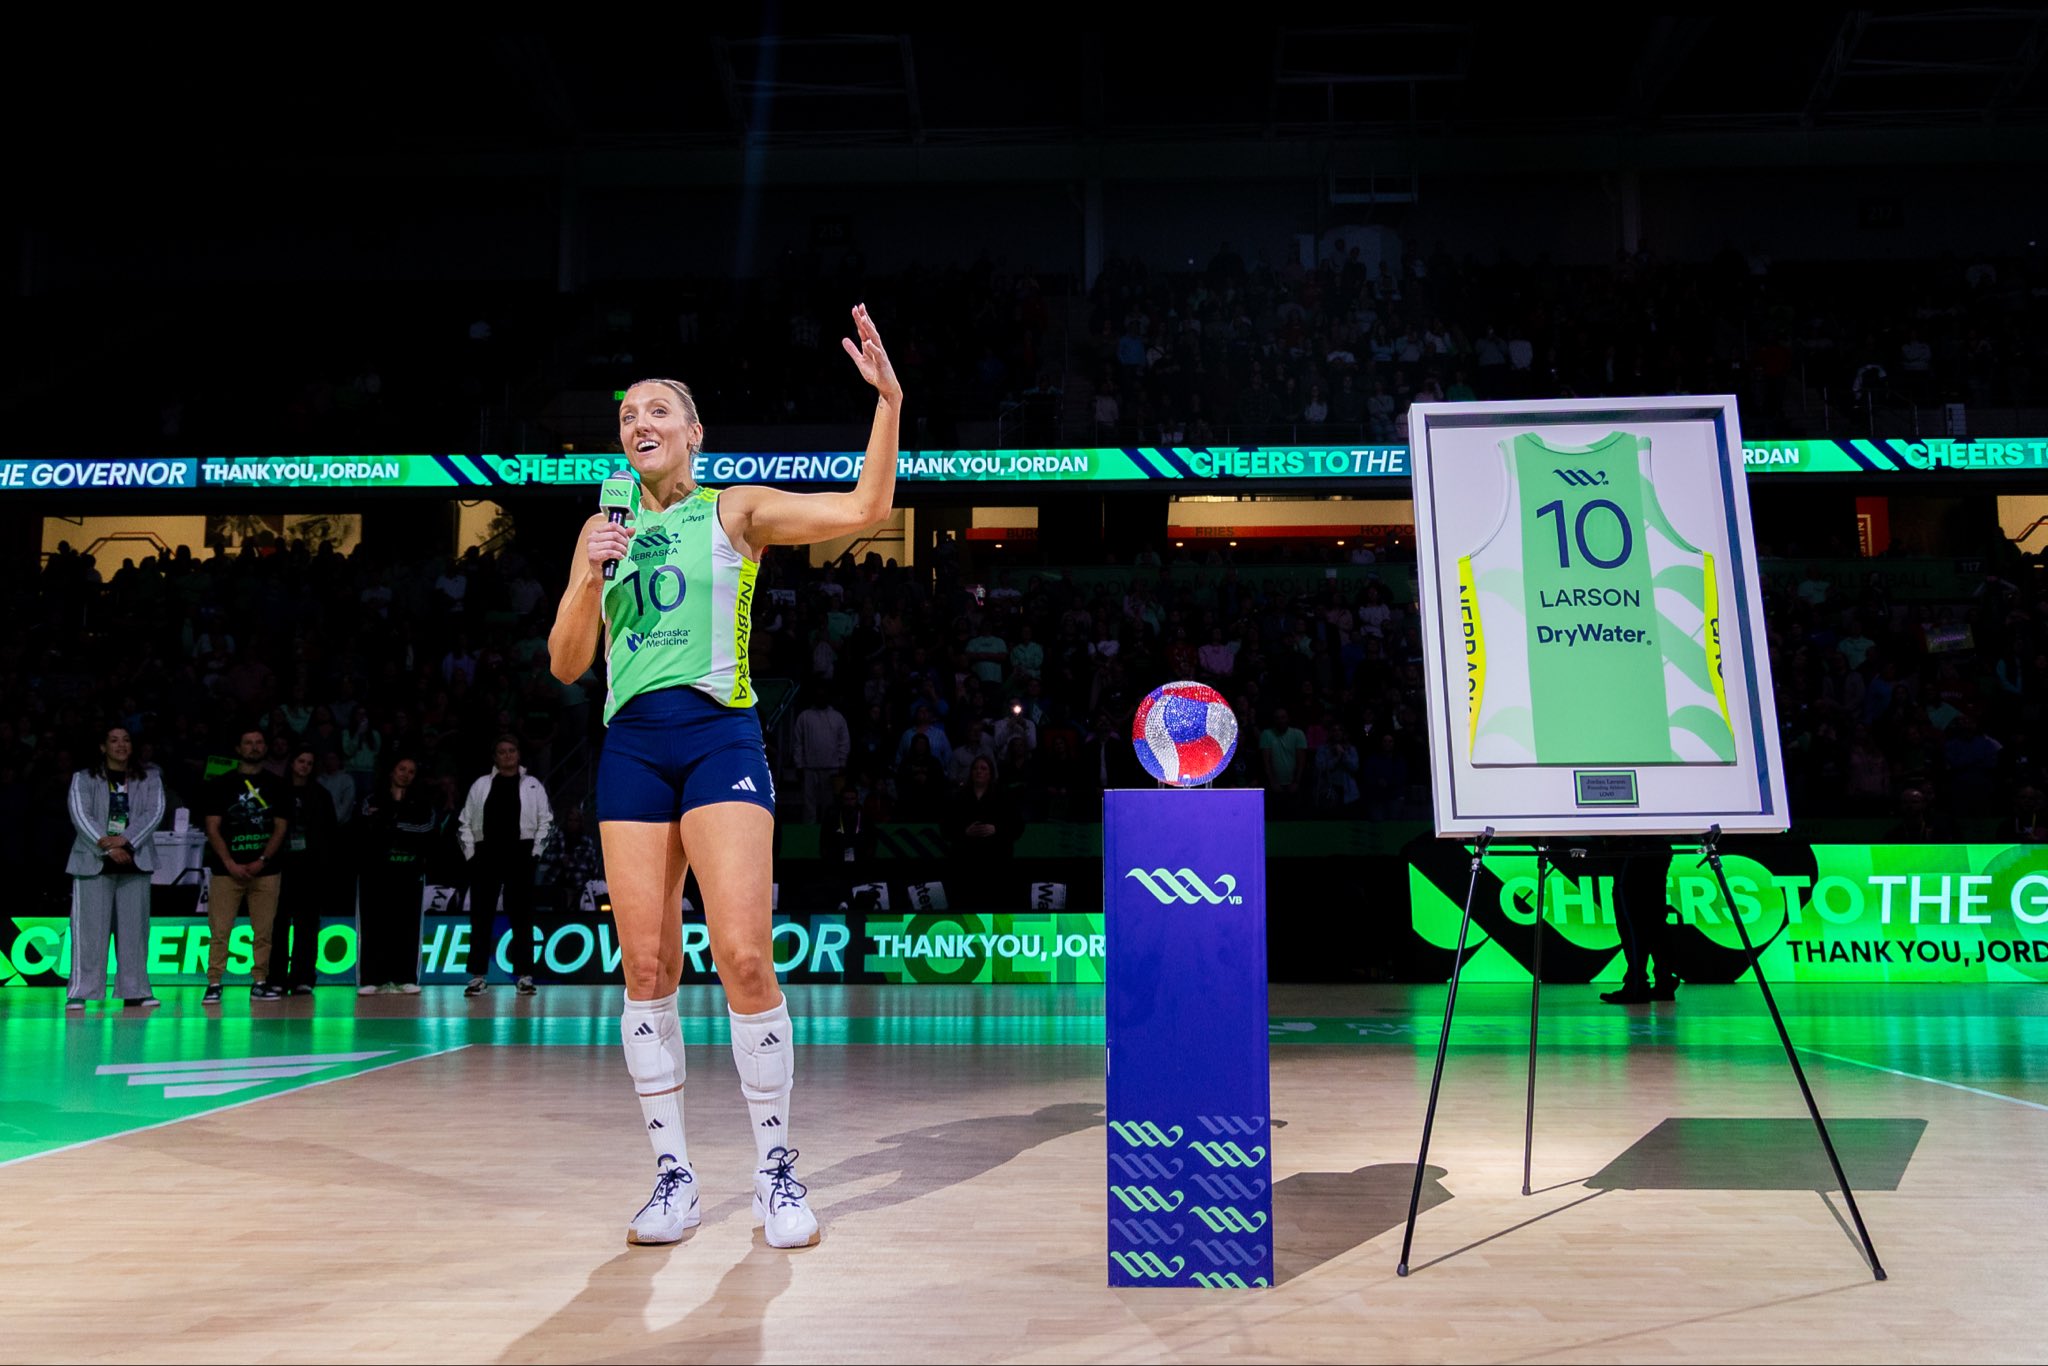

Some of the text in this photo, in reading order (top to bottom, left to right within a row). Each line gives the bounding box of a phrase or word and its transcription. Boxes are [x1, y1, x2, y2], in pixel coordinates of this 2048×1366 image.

[897, 456, 1088, 476] HANK YOU, JORDAN
[1189, 450, 1406, 476] CHEERS TO THE
[1743, 447, 1799, 465] RDAN
[1904, 442, 2048, 468] CHEERS T
[31, 462, 187, 487] GOVERNOR
[201, 462, 399, 482] THANK YOU, JORDAN
[499, 457, 607, 482] CHEERS
[1536, 498, 1633, 570] 10
[628, 547, 679, 564] NEBRASKA
[622, 564, 687, 617] 10
[1539, 588, 1640, 608] LARSON
[646, 637, 689, 649] Medicine
[734, 580, 754, 701] NEBRASKA
[232, 832, 272, 843] JORDA
[1228, 895, 1243, 905] VB
[1771, 875, 1865, 924] TO
[1868, 875, 1992, 924] THE
[11, 925, 255, 975] CERS
[421, 924, 472, 973] HE
[495, 923, 850, 973] GOVROR
[873, 934, 1106, 962] THANK YOU, JOR
[1787, 940, 1894, 963] THANK
[1897, 940, 1970, 967] YOU,
